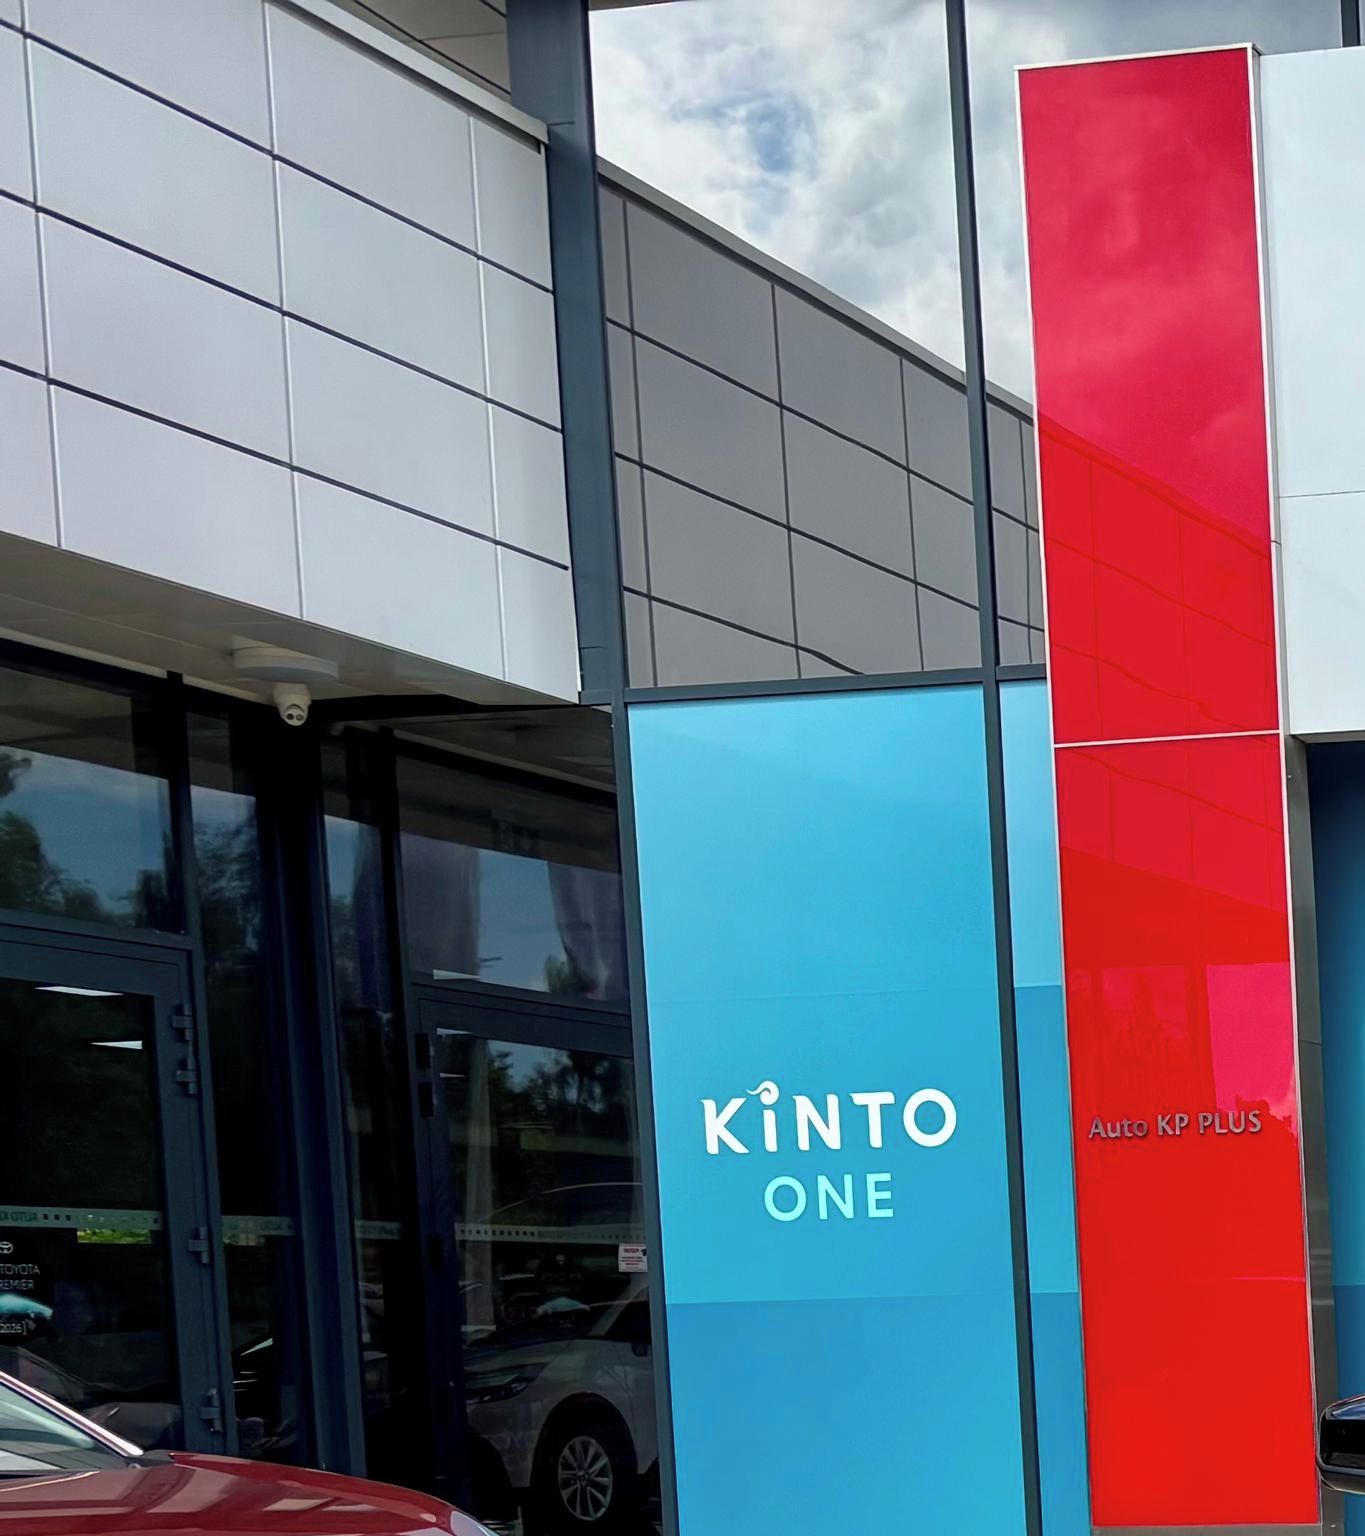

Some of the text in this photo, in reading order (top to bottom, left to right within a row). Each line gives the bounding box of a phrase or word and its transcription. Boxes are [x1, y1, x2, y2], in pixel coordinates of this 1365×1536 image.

[1088, 1110, 1263, 1139] Auto KP PLUS
[763, 1172, 894, 1222] ONE
